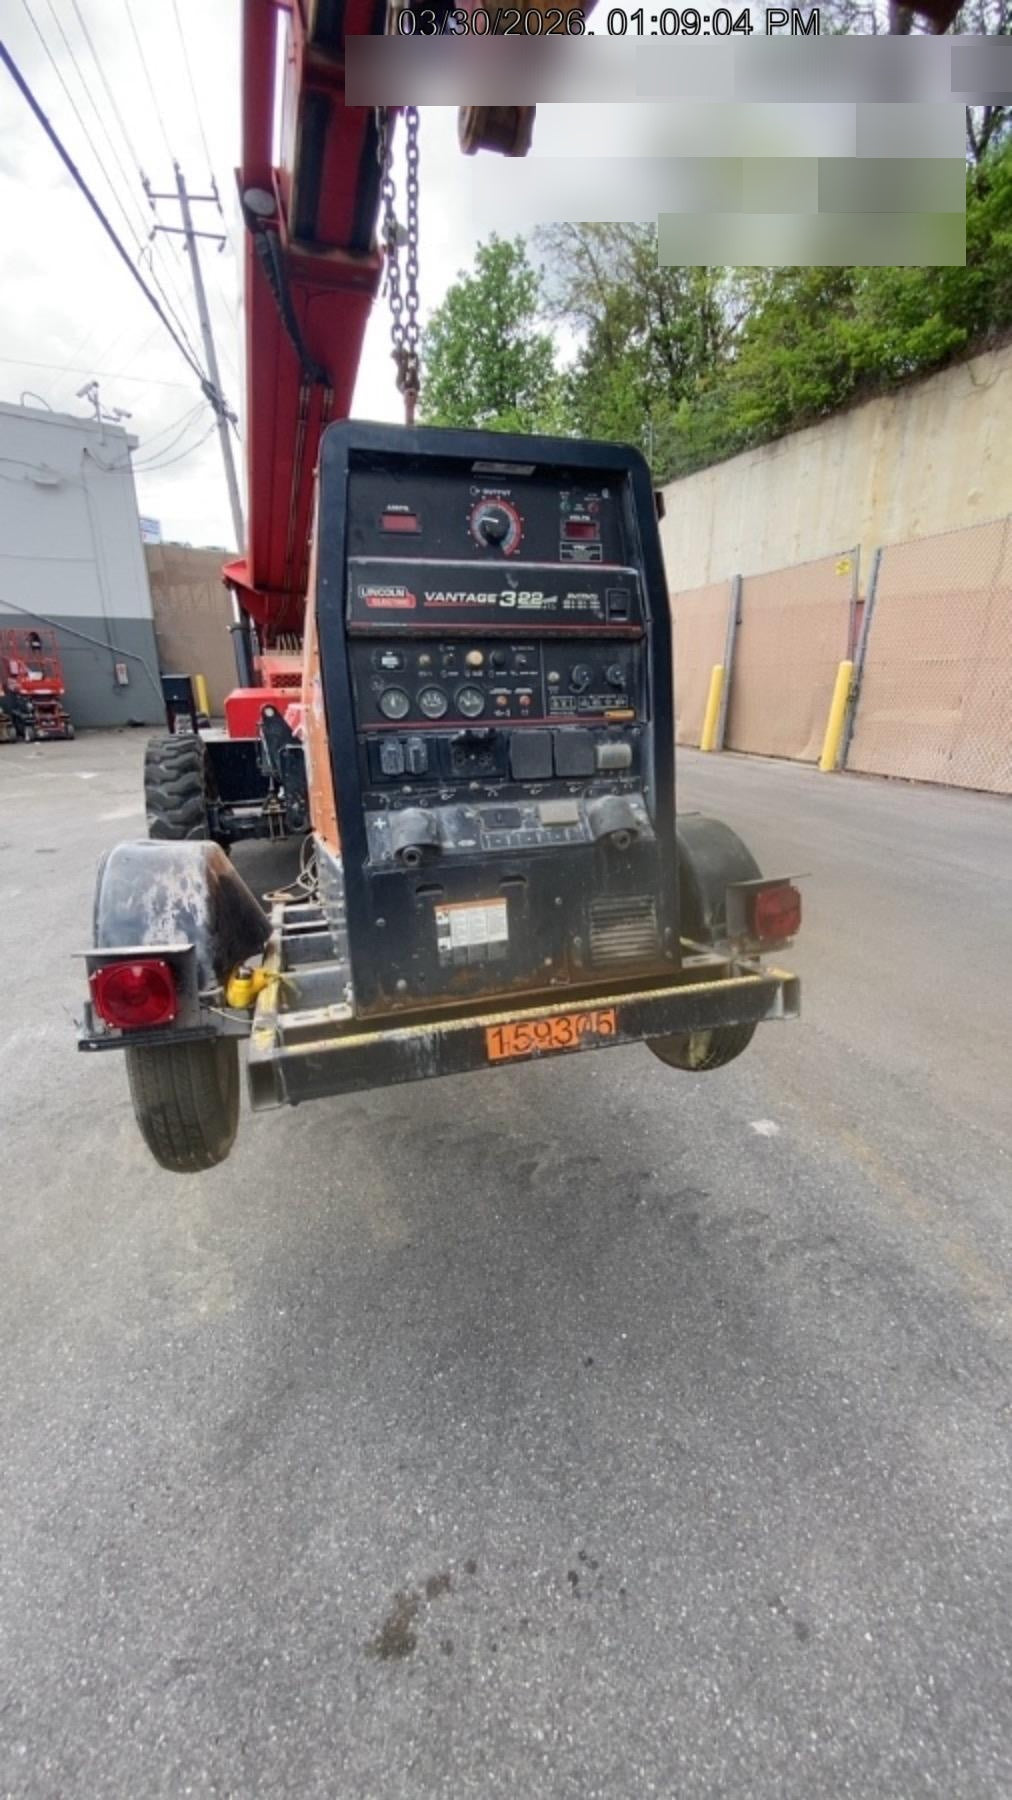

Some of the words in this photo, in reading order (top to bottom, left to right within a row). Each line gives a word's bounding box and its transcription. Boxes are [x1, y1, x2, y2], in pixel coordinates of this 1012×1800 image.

[361, 586, 405, 597] LINCOLN
[424, 591, 497, 603] VANTAGE
[499, 590, 544, 607] 322
